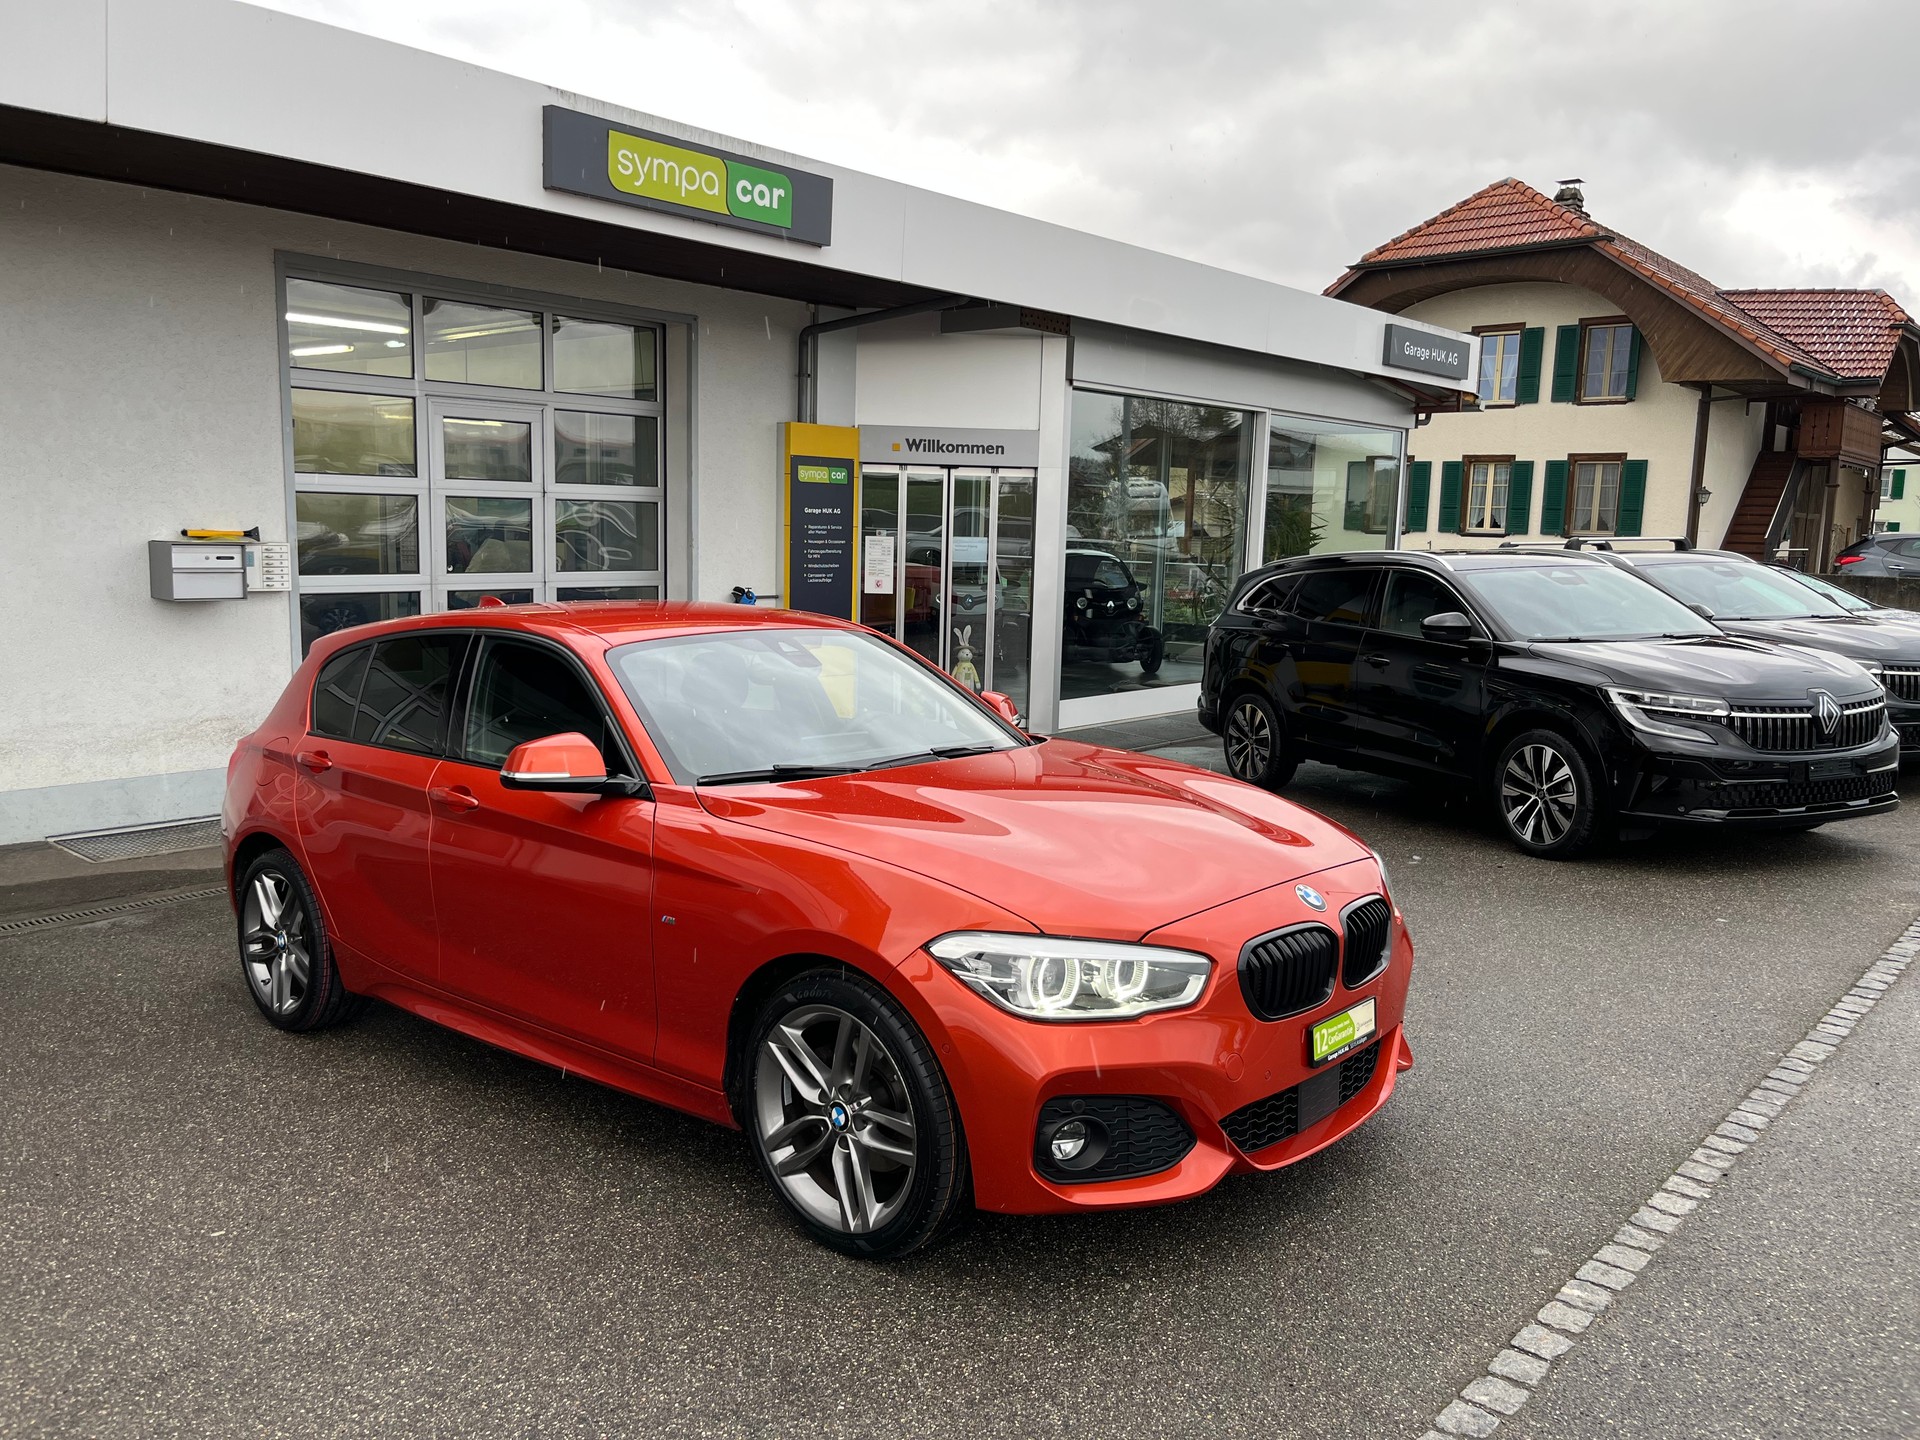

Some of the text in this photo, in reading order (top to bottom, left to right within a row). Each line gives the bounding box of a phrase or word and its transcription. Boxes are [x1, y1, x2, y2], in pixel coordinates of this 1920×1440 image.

[617, 149, 785, 209] sympa car
[1404, 341, 1458, 365] Garage HUK AG
[905, 438, 1005, 455] Willkommen
[800, 469, 846, 480] sympa car
[804, 507, 821, 515] Garage
[1315, 1028, 1329, 1054] 12
